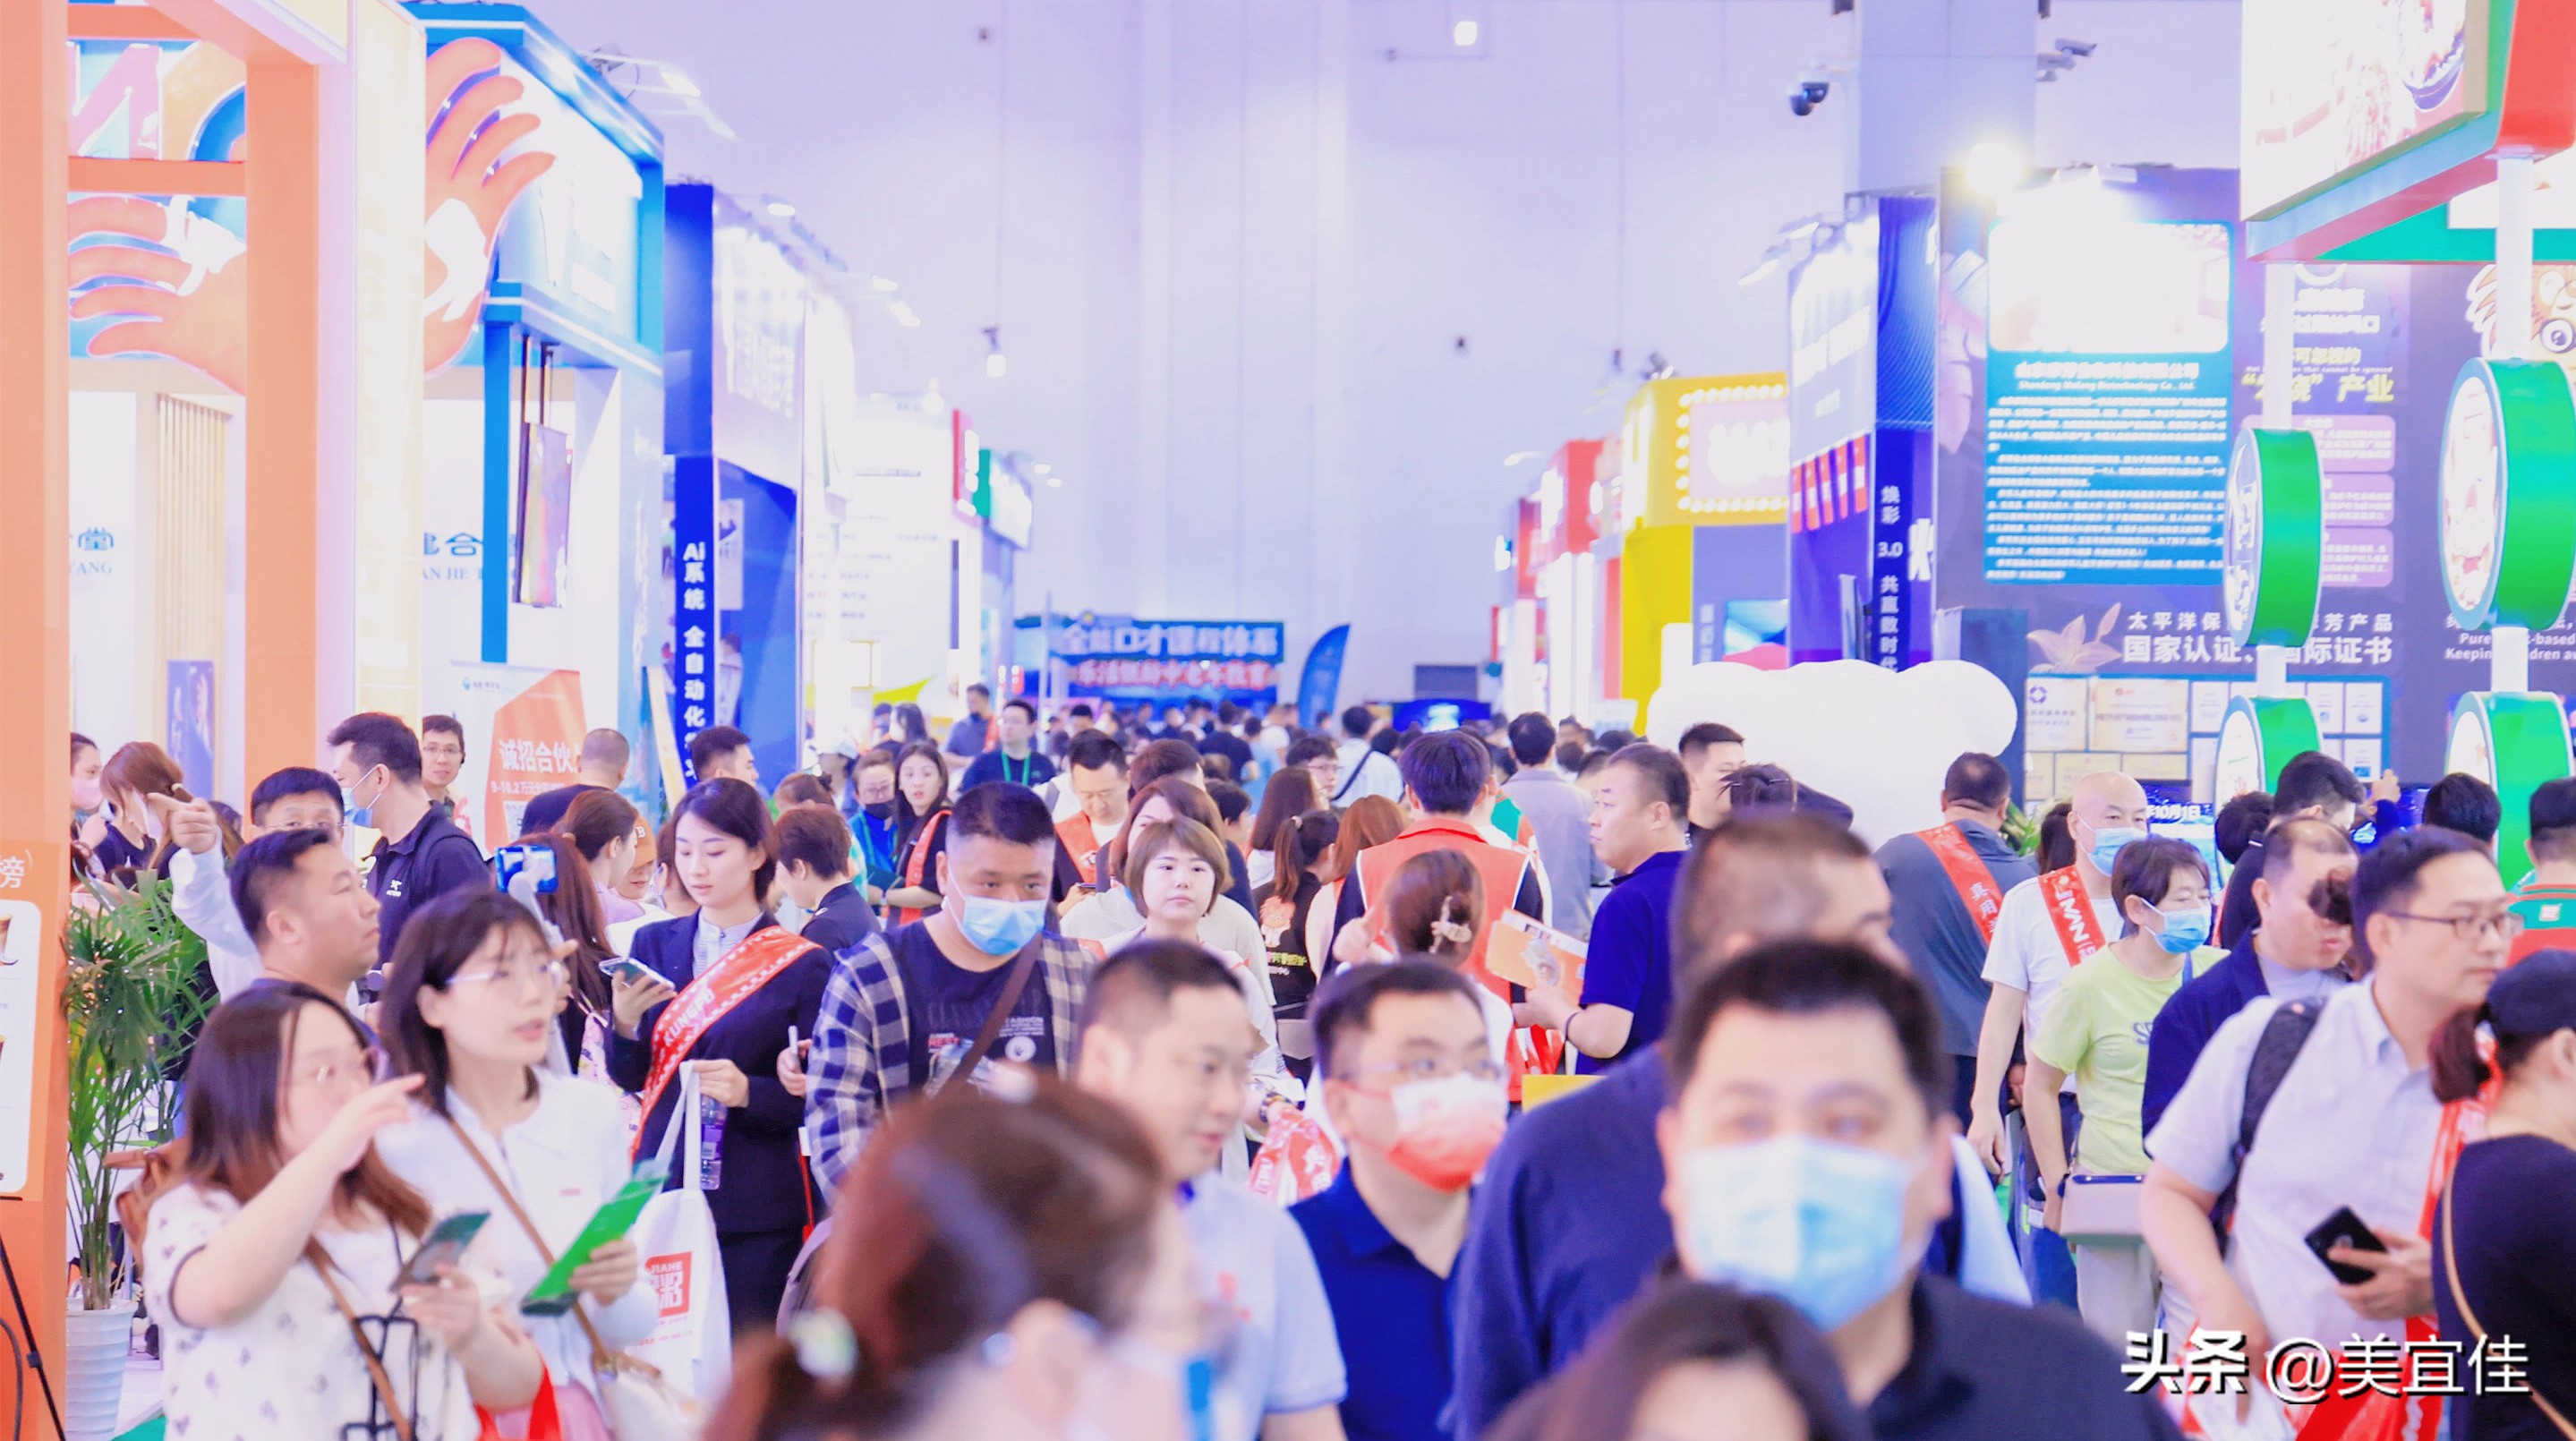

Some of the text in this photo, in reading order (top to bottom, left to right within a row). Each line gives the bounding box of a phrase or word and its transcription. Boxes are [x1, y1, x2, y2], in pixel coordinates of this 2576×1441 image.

[2337, 373, 2394, 402] 产业
[1877, 541, 1904, 558] 3.0
[2128, 611, 2393, 632] 太平洋保芳产品
[2460, 632, 2576, 645] Pure -based
[2444, 647, 2492, 662] Keepin
[2529, 647, 2561, 661] dren
[635, 825, 646, 839] B
